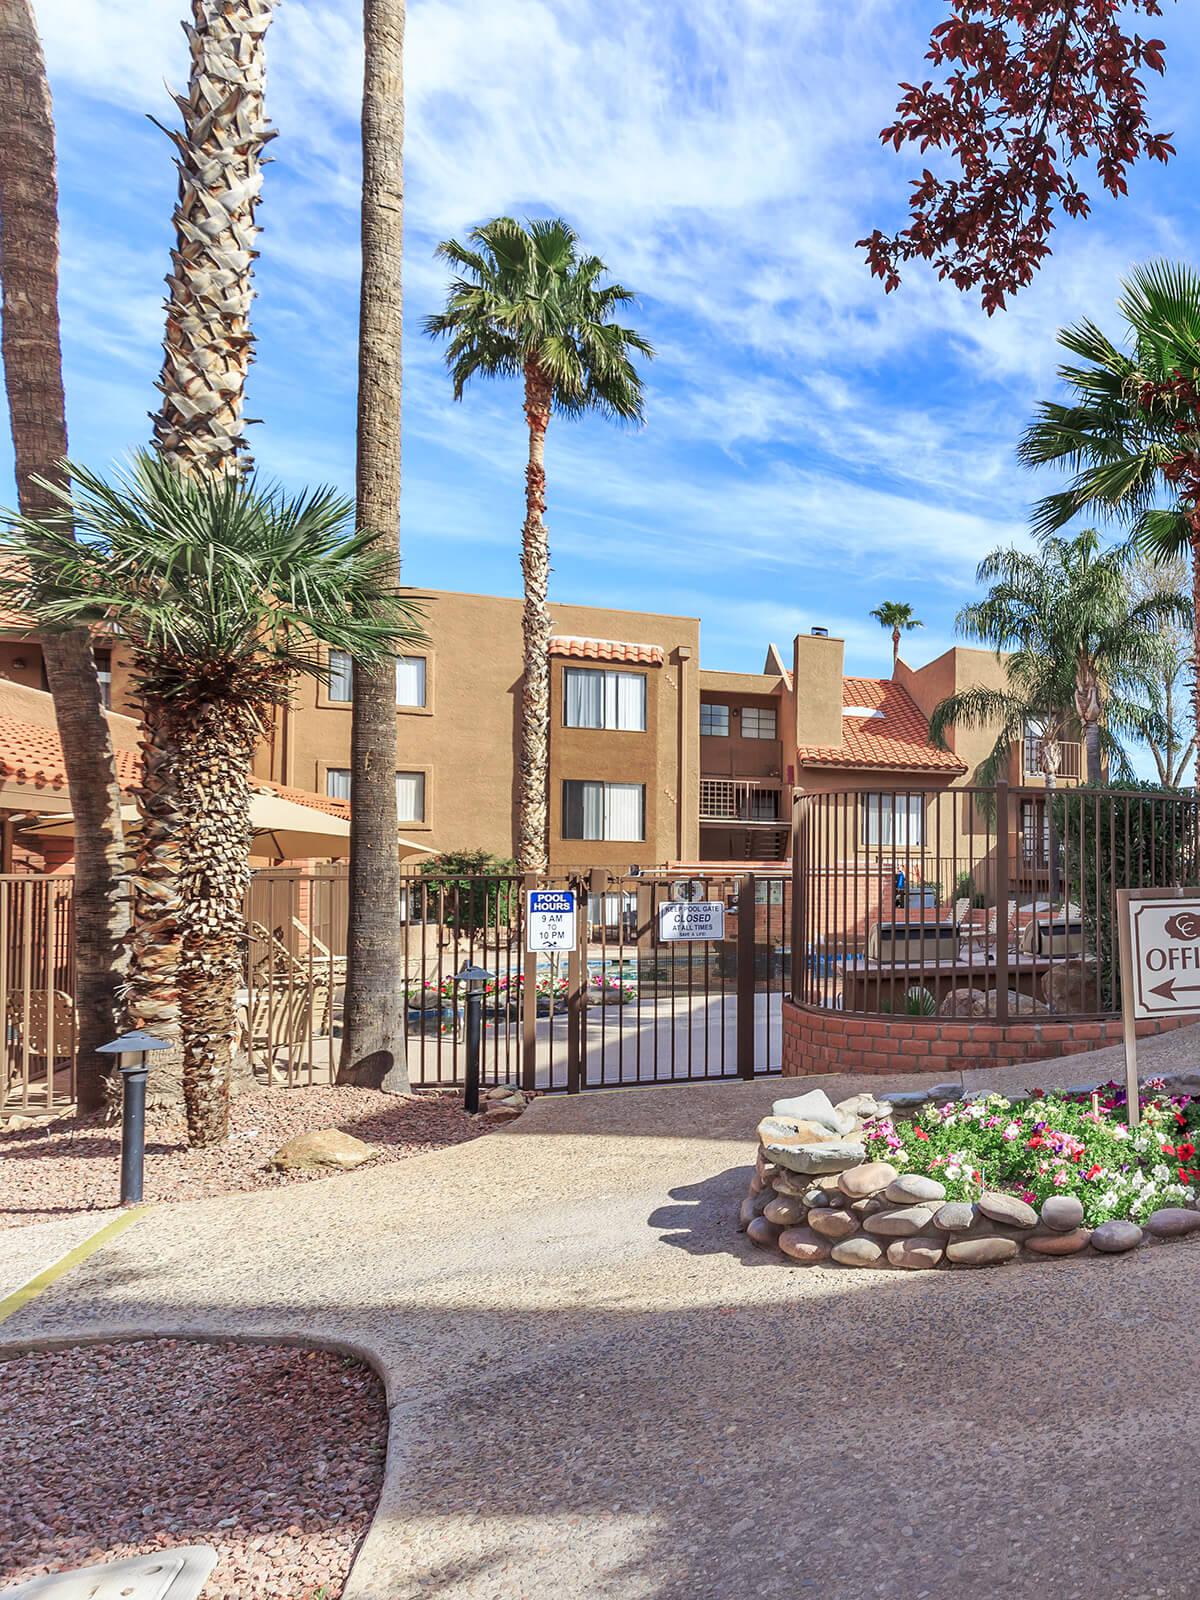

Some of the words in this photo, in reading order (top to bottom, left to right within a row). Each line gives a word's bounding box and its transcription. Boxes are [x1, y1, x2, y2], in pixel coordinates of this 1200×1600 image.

[537, 894, 566, 902] POOL
[674, 914, 711, 923] CLOSED
[540, 931, 549, 939] 10
